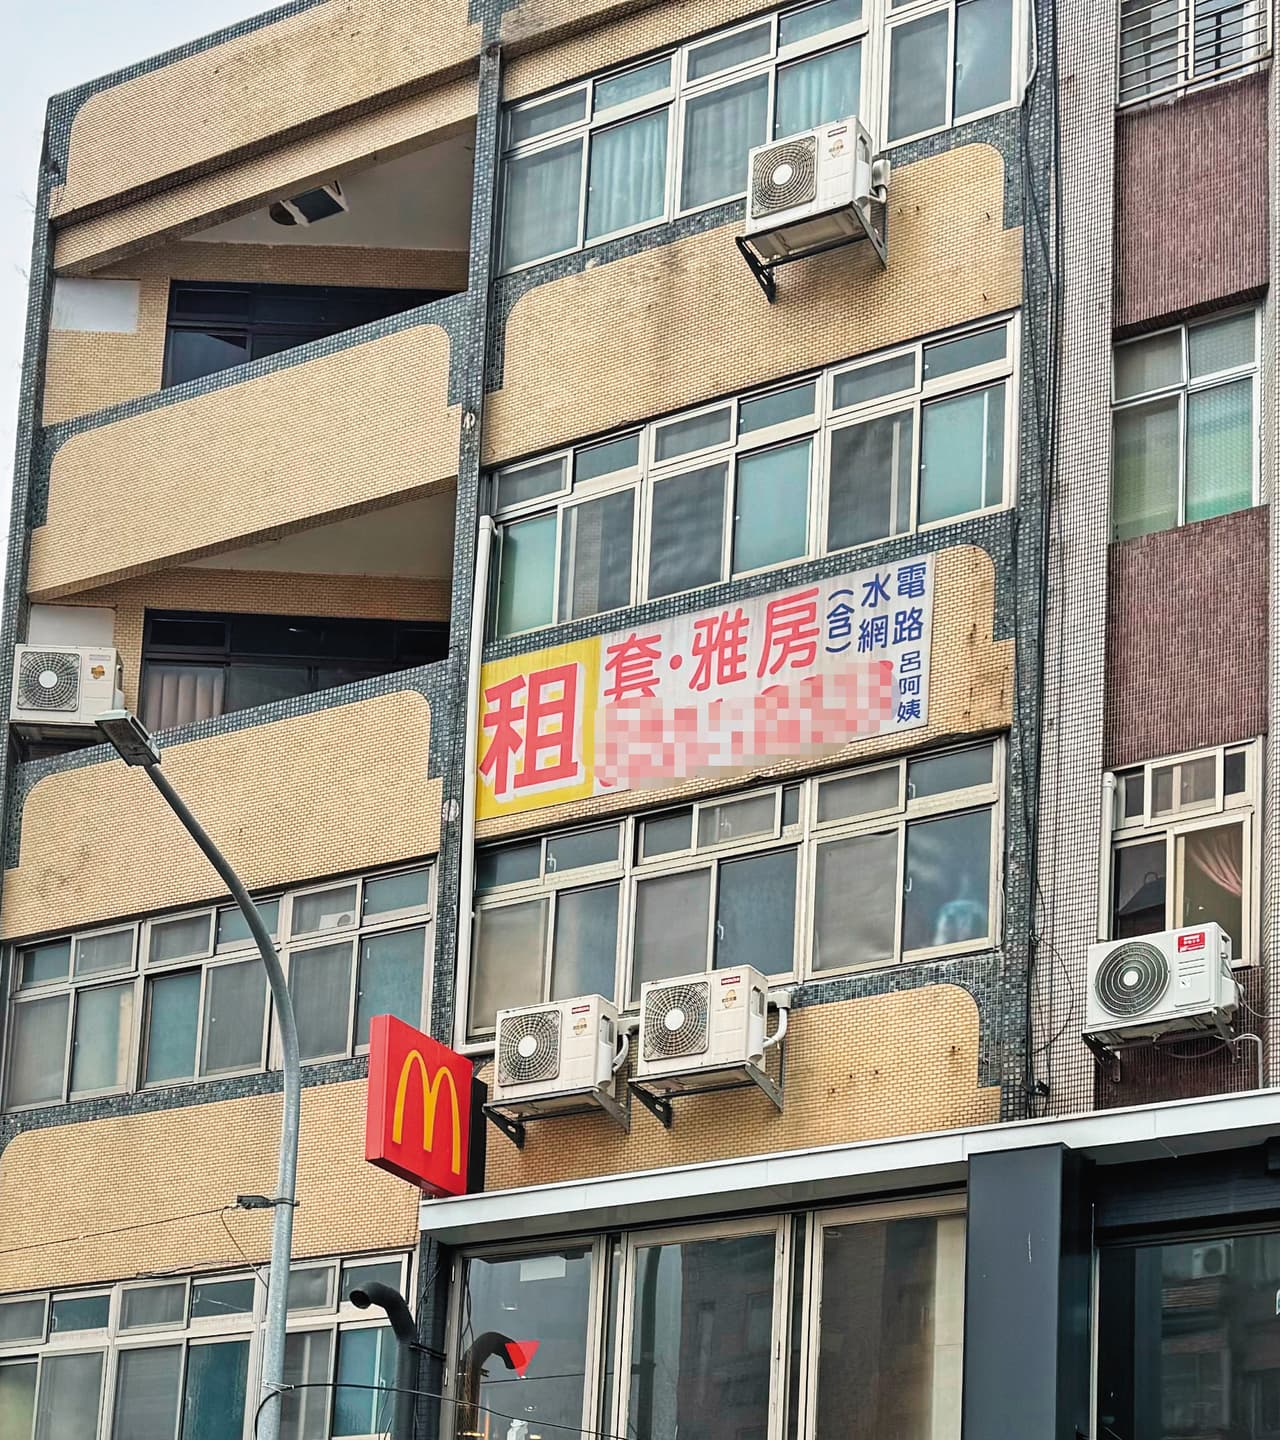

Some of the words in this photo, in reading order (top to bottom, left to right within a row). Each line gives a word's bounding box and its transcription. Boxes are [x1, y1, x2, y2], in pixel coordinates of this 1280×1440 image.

[861, 562, 928, 608] 水電
[856, 606, 925, 654] 網路
[896, 650, 922, 724] 呂阿姨
[478, 661, 580, 797] 租
